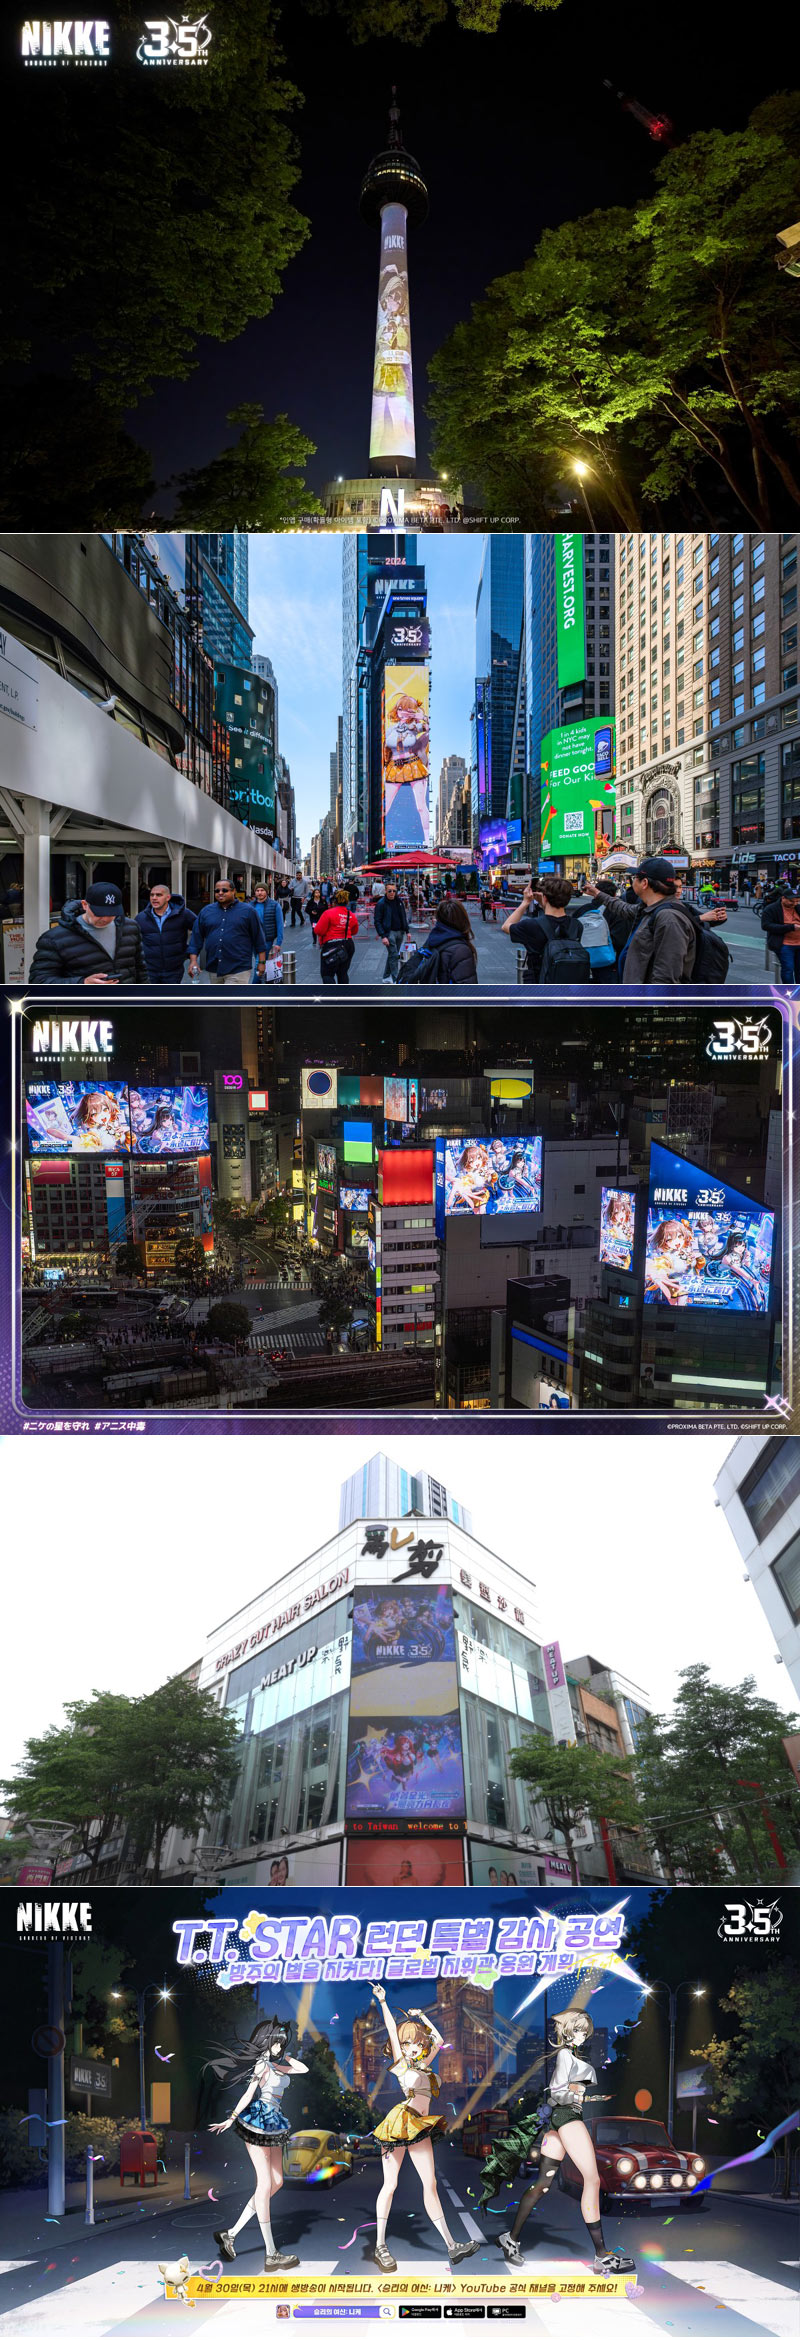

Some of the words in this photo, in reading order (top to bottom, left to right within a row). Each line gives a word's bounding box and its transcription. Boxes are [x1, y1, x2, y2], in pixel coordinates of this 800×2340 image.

[229, 725, 243, 733] See
[563, 736, 577, 744] NYC
[578, 734, 590, 742] may
[554, 752, 571, 760] dinner
[572, 747, 594, 756] tonight.
[550, 768, 570, 778] FEED
[573, 763, 595, 773] GOO
[550, 778, 561, 788] For
[564, 777, 581, 785] Our
[584, 773, 595, 781] Ki
[250, 824, 273, 837] Nasdaq
[732, 852, 756, 864] Lids
[772, 853, 796, 862] TACO
[105, 894, 115, 904] NY
[222, 1074, 243, 1089] 109
[29, 1085, 51, 1094] NIKKE
[654, 1188, 688, 1202] NIKKE
[688, 1211, 709, 1220] NIKKE
[216, 1639, 248, 1672] CRAZY
[250, 1622, 272, 1648] CUT
[272, 1603, 300, 1633] HAIR
[304, 1568, 349, 1611] SALON
[376, 1645, 405, 1656] NIKKE
[260, 1658, 296, 1691] MEAT
[297, 1645, 318, 1668] UP
[547, 1646, 556, 1671] MEAT
[552, 1670, 559, 1686] UP
[353, 1822, 363, 1830] to
[367, 1822, 398, 1830] Taiwan
[408, 1822, 444, 1830] welcome
[549, 1860, 566, 1870] MEAT
